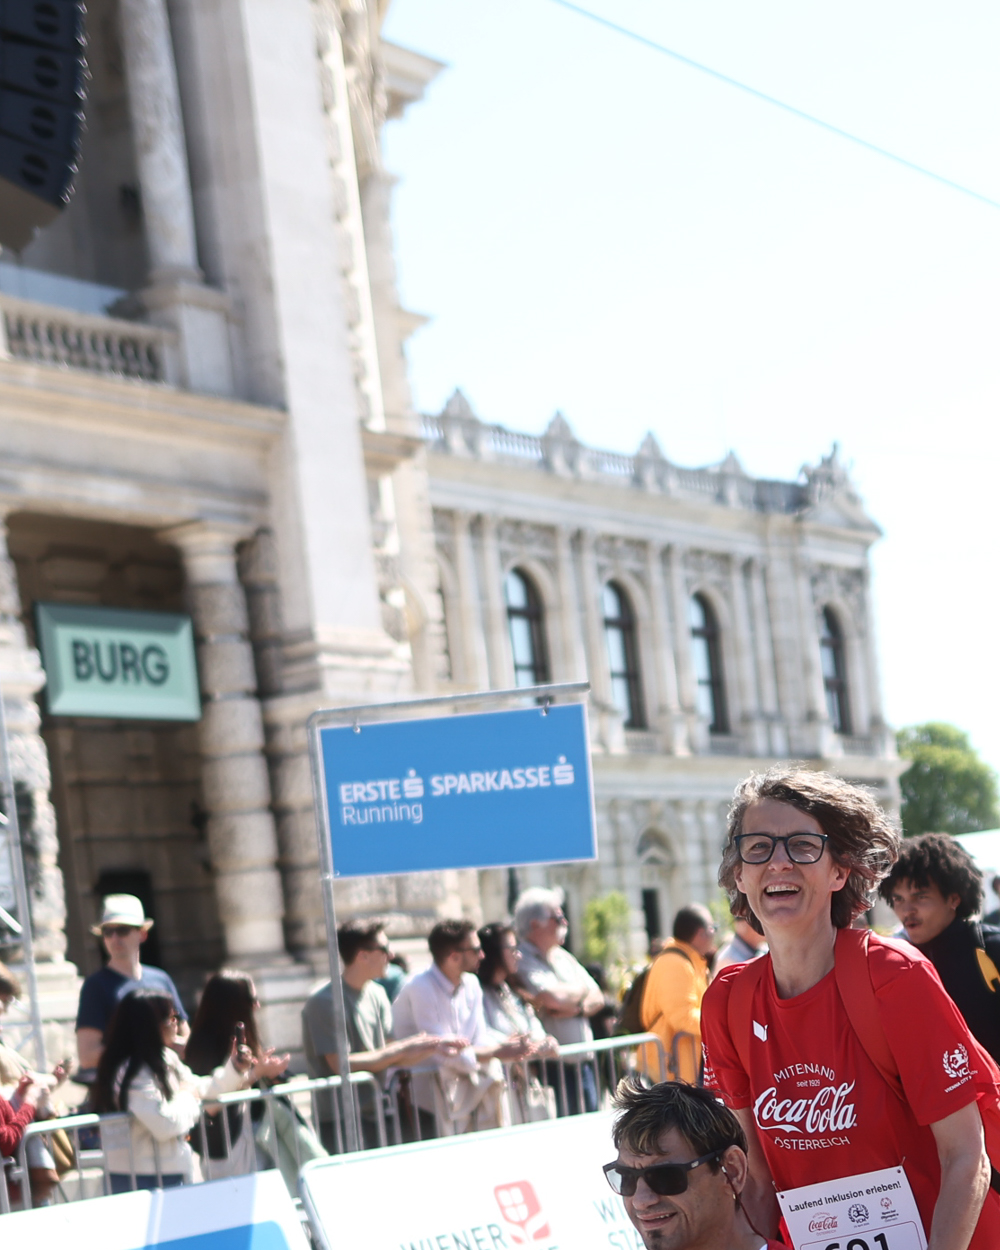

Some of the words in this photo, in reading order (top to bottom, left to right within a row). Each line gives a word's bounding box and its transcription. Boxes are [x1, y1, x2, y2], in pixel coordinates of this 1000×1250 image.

[72, 638, 170, 686] BURG
[340, 780, 401, 804] ERSTE
[430, 766, 551, 796] SPARKASSE
[342, 801, 424, 825] Running
[773, 1062, 836, 1083] MITENAND
[796, 1080, 808, 1088] seit
[753, 1079, 857, 1134] Coca-Cola
[774, 1135, 851, 1151] ÖSTERREICH
[788, 1198, 823, 1212] Laufend
[824, 1189, 864, 1204] Inklusion
[865, 1181, 902, 1195] erleben!
[808, 1215, 838, 1233] Coca-Cola
